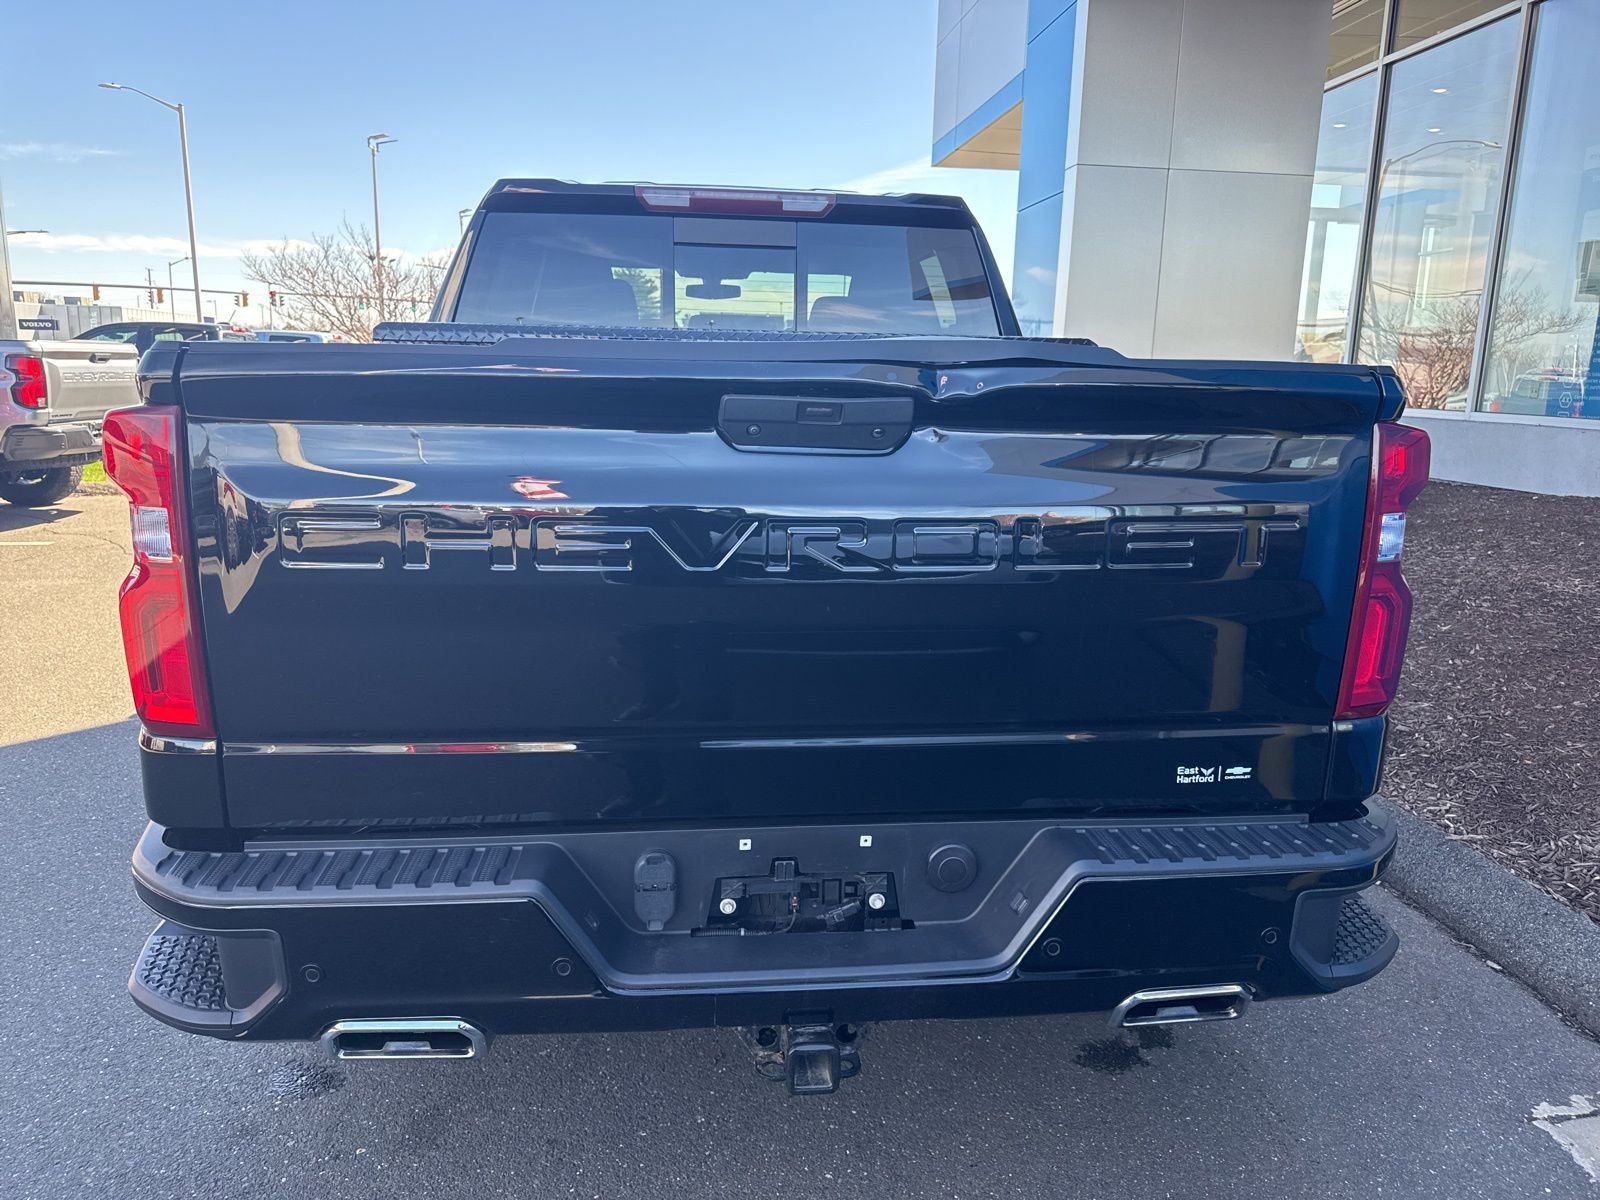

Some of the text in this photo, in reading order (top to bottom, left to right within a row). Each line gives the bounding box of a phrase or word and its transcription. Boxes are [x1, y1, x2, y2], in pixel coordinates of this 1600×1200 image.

[277, 510, 1301, 572] CHEVROLET
[1177, 766, 1199, 775] East
[1176, 775, 1215, 783] Hartford
